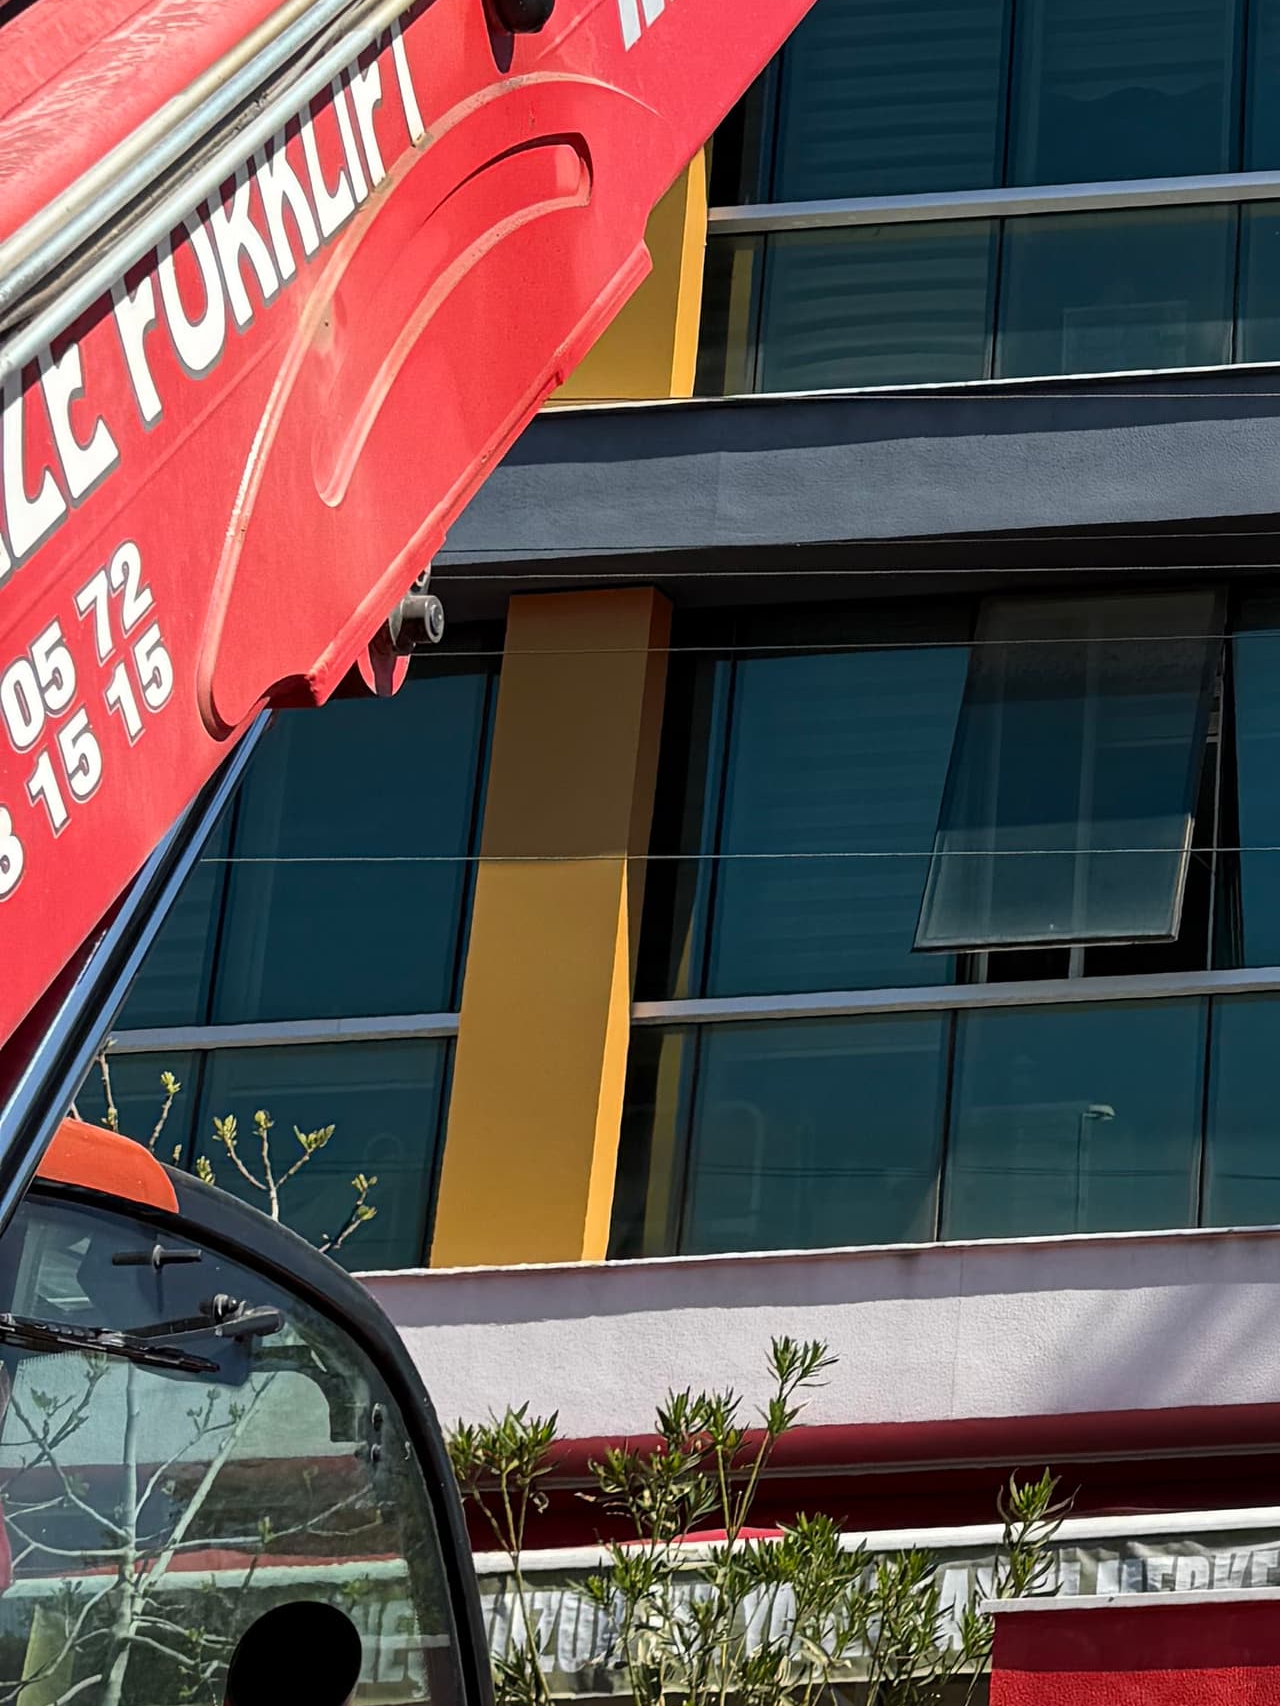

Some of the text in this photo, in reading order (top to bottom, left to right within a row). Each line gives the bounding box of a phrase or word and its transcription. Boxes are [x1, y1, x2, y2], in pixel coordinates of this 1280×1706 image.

[74, 539, 156, 668] 72
[25, 705, 103, 838] 15
[104, 619, 174, 746] 15
